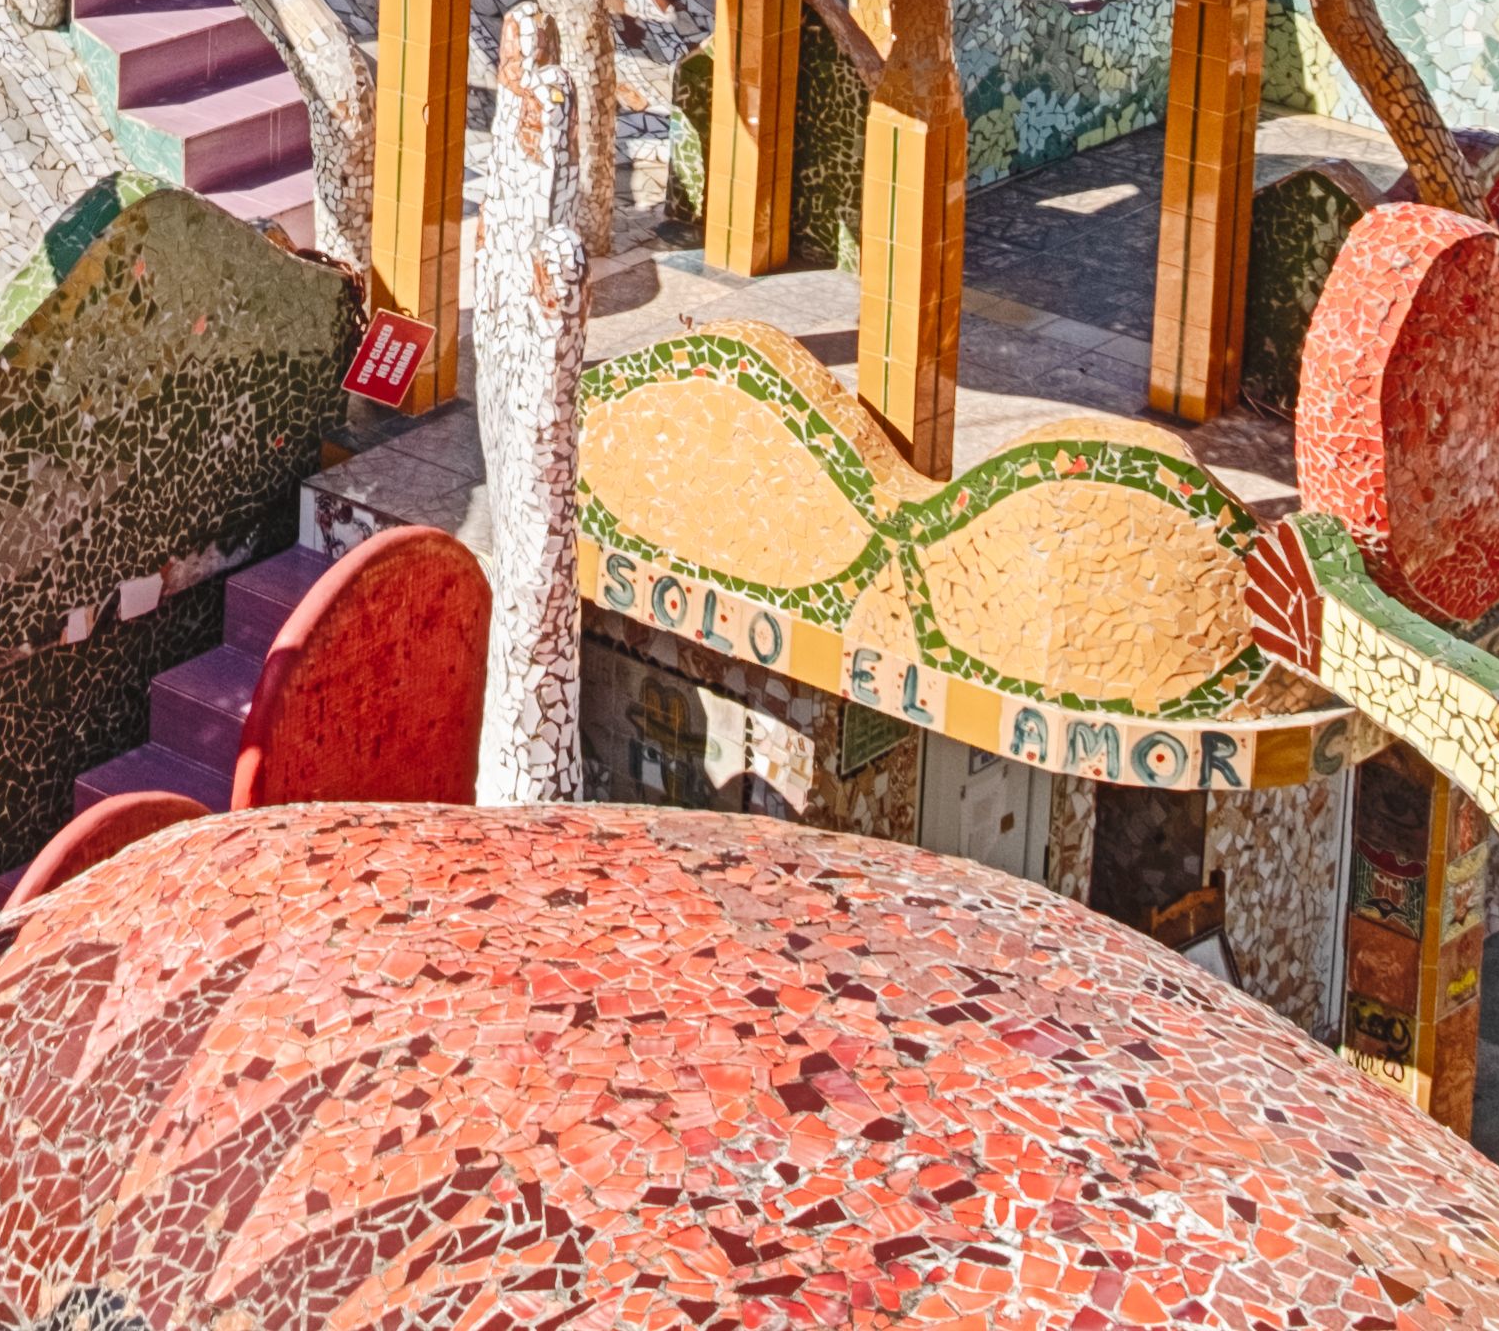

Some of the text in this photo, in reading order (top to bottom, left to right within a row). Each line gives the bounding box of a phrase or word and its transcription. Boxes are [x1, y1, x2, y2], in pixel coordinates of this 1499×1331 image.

[356, 324, 394, 385] STOP CLOSED
[375, 339, 403, 378] NO PASE
[388, 341, 417, 386] CERRADO
[603, 552, 783, 666] SOLO
[851, 647, 934, 725] EL
[1009, 705, 1244, 789] AMOR
